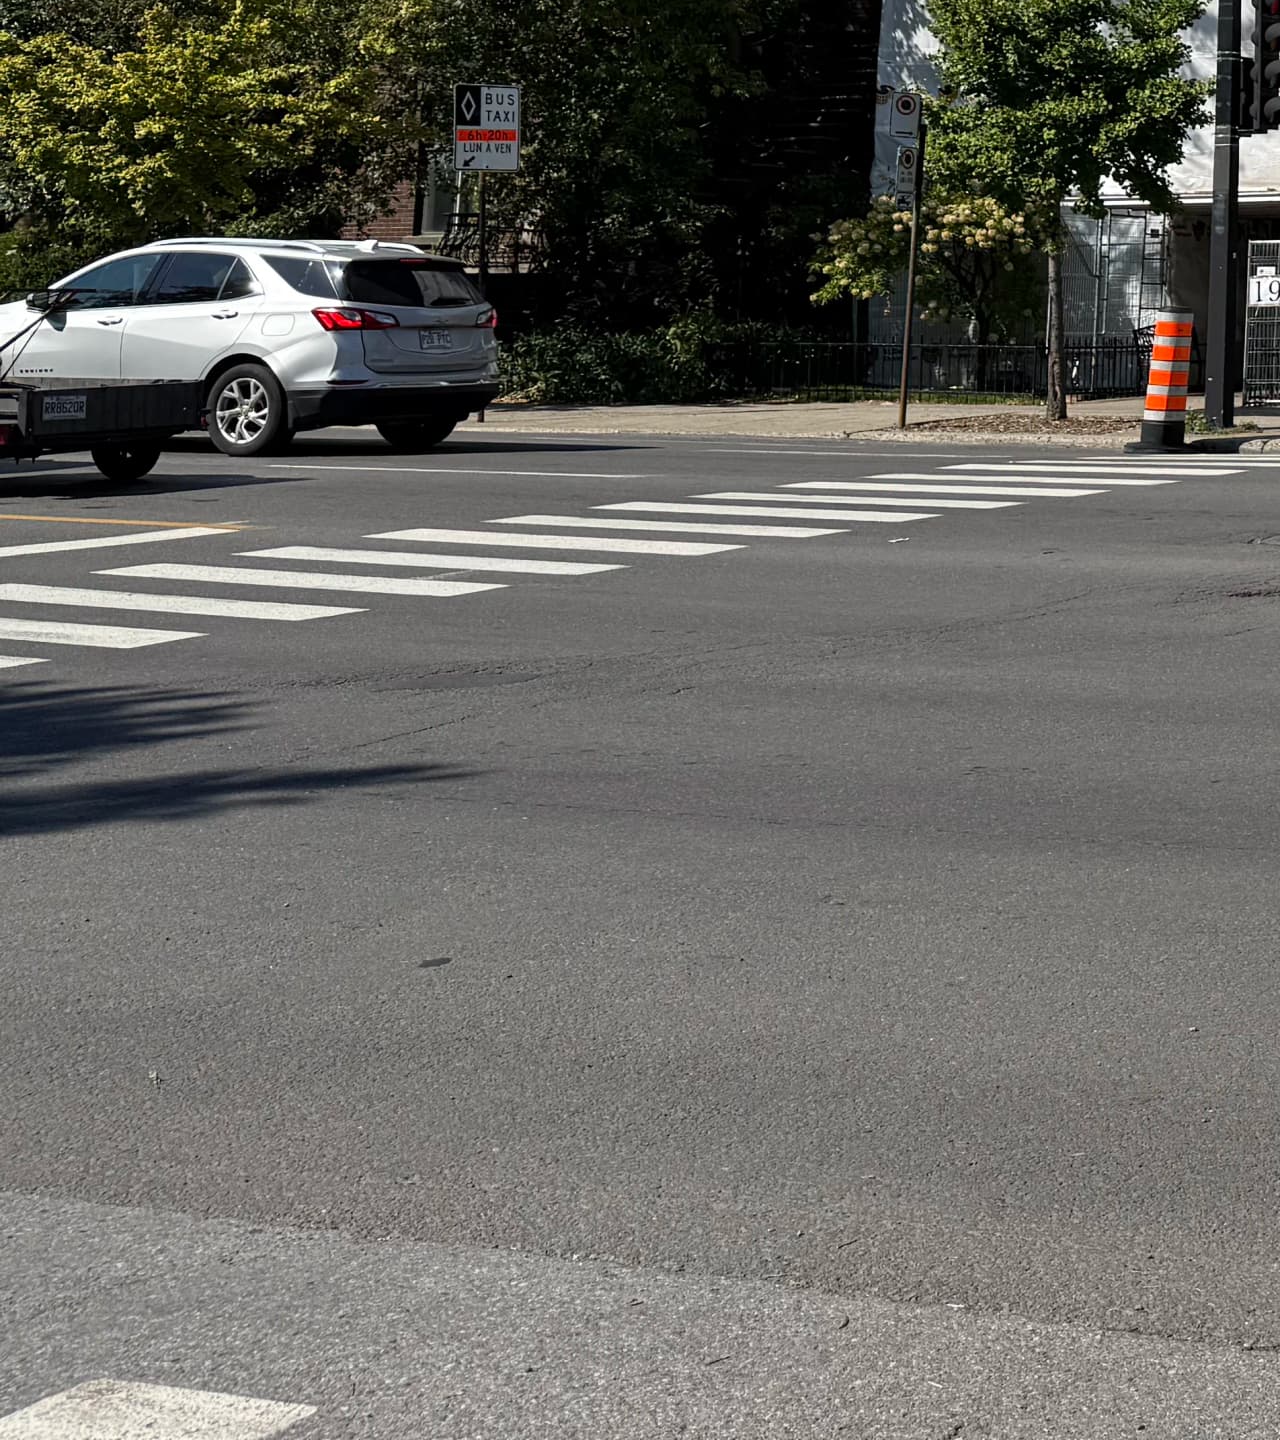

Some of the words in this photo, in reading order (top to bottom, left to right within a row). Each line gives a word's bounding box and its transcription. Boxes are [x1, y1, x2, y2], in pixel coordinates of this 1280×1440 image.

[485, 93, 515, 106] BUS
[485, 110, 515, 123] TAXI
[463, 143, 482, 153] LUN
[494, 143, 512, 154] VEN
